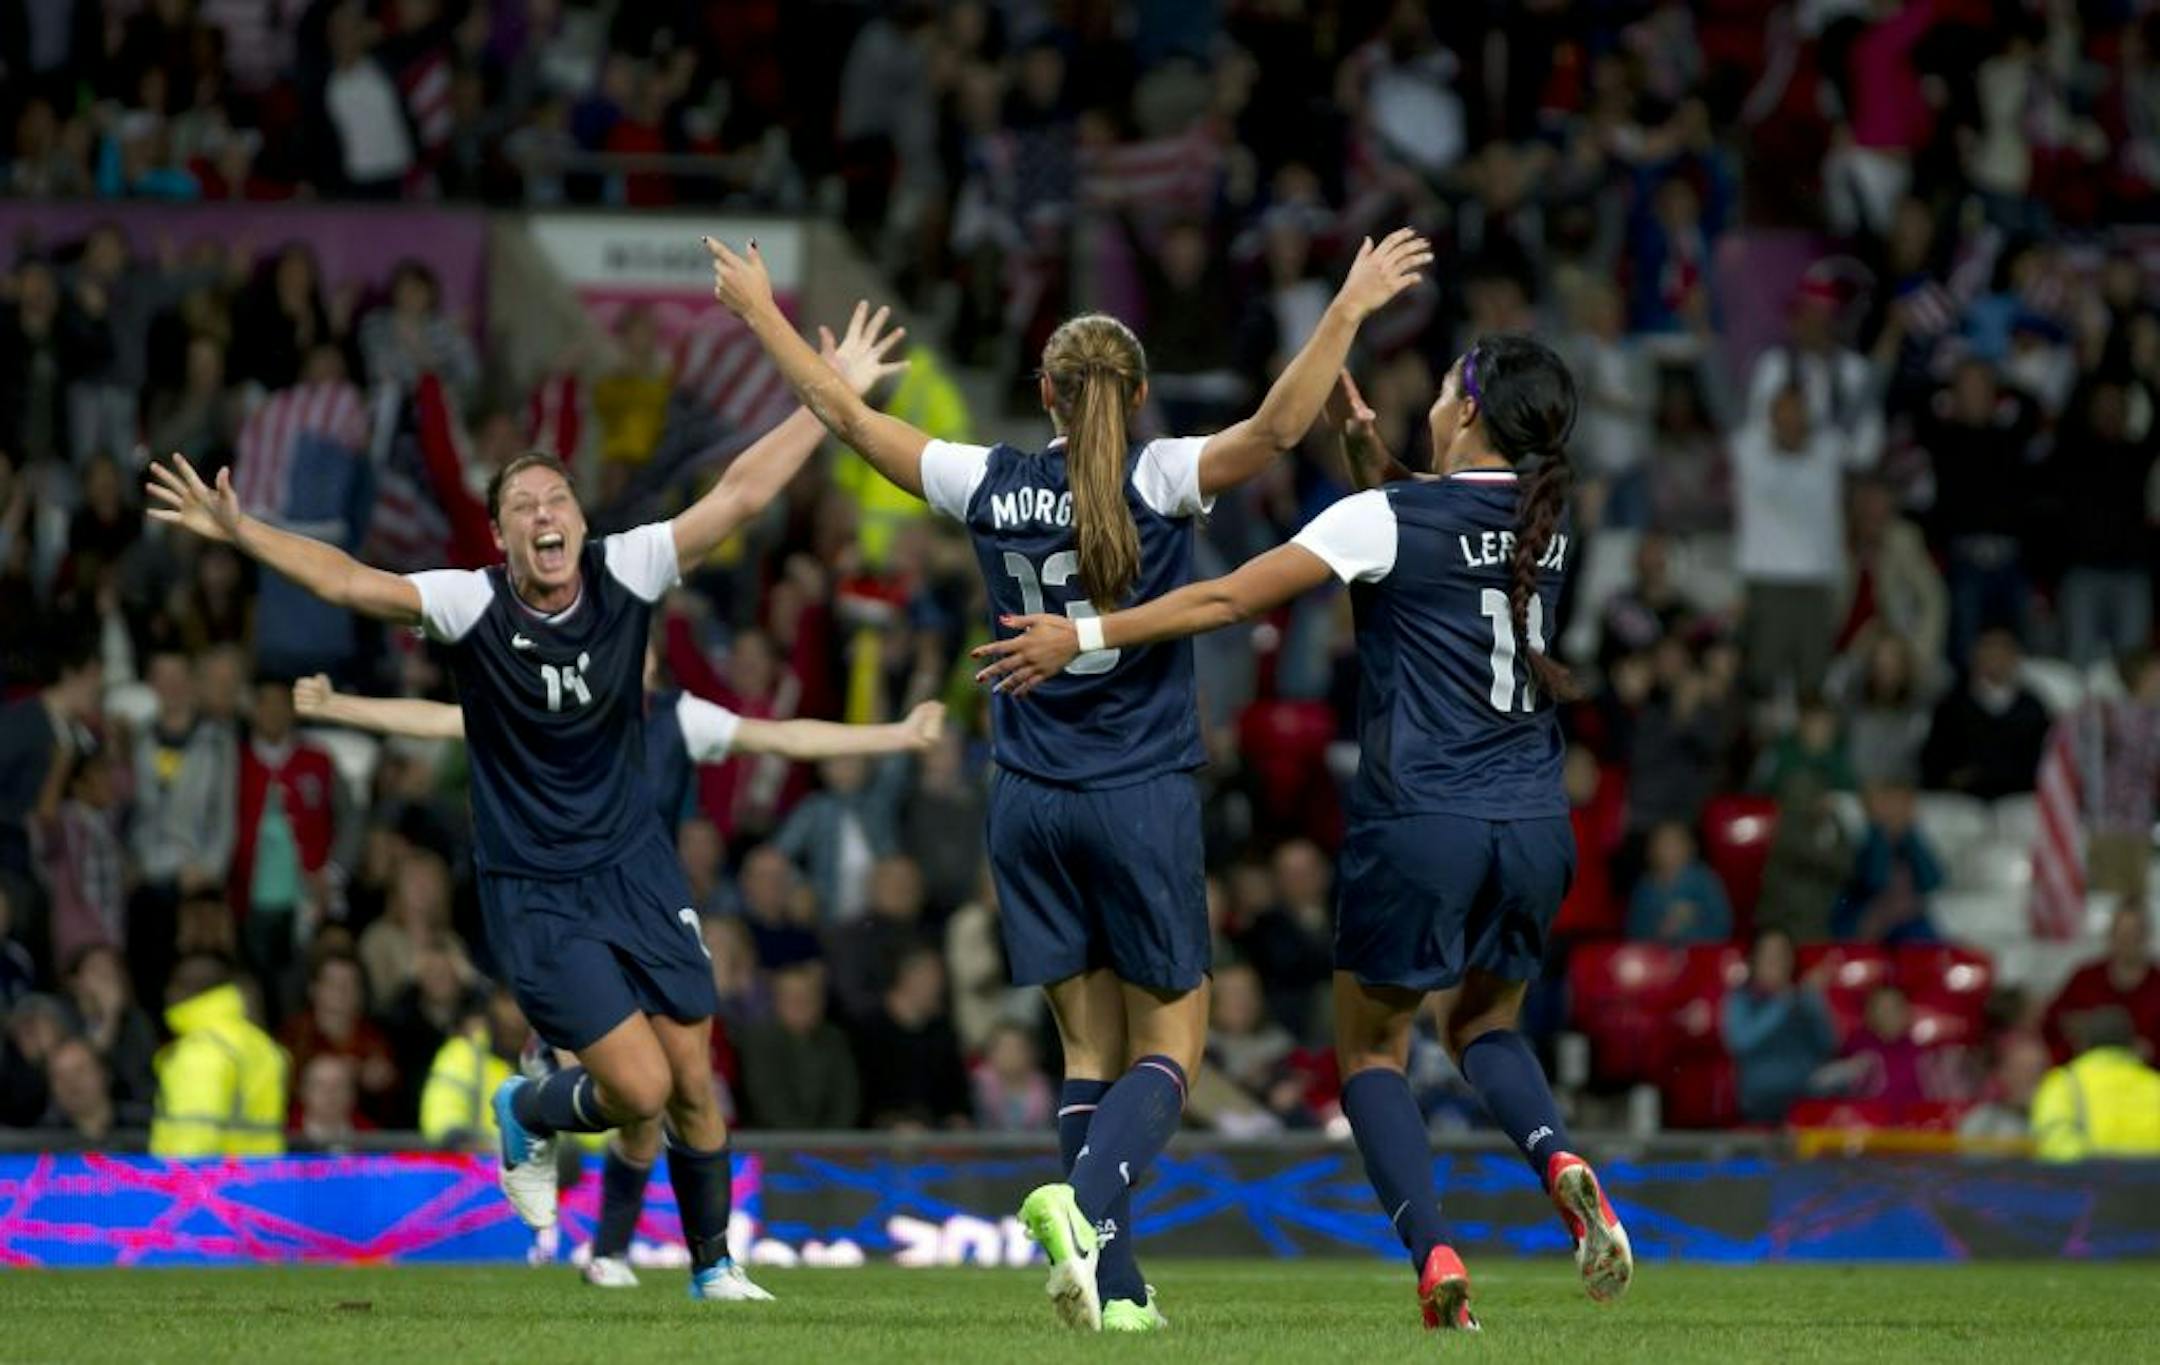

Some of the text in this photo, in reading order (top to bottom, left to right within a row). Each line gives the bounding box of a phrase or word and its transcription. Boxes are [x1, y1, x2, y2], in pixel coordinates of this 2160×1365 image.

[991, 486, 1075, 529] MORG
[1459, 530, 1568, 571] LERUX
[541, 651, 592, 712] 14
